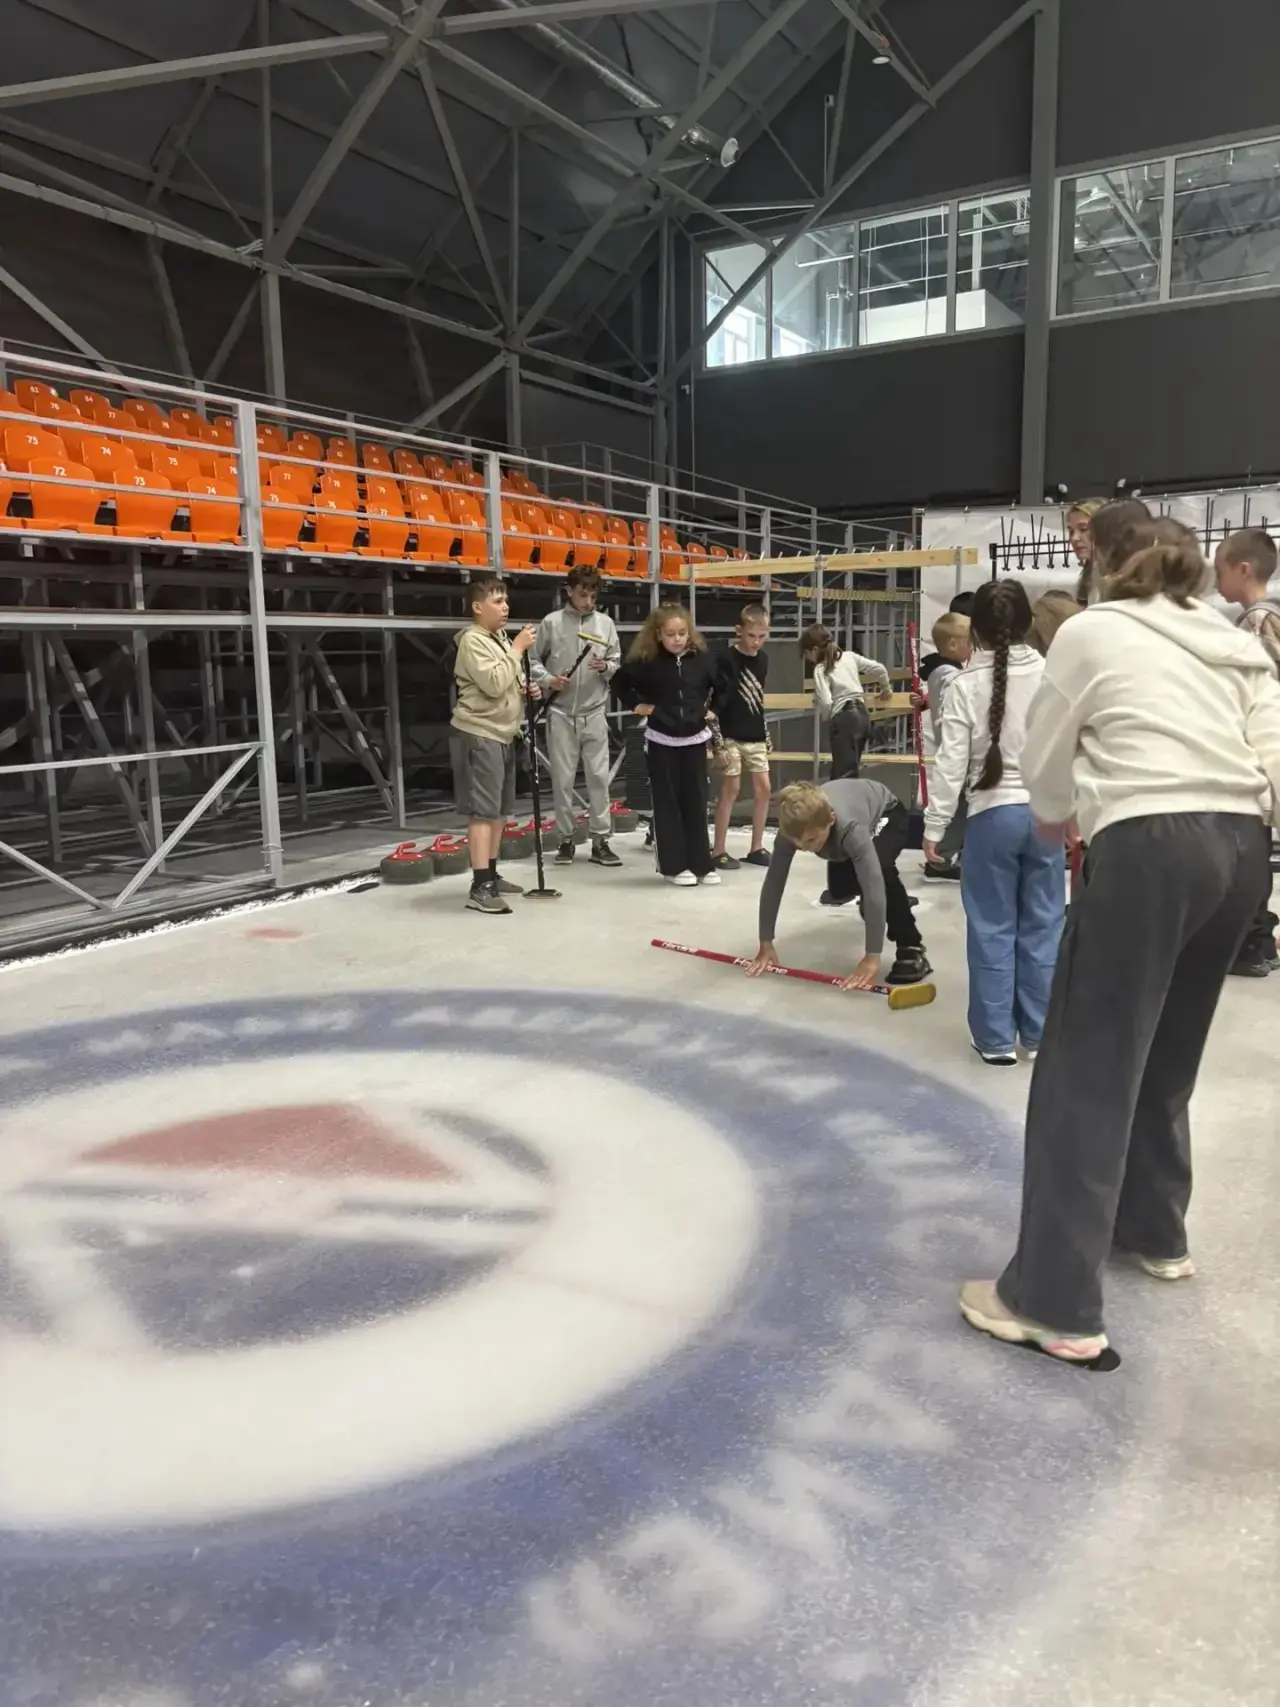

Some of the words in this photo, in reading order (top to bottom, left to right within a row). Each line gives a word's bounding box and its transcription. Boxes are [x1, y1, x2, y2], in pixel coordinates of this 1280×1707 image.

[50, 402, 60, 410] 76
[108, 411, 116, 419] 77
[26, 435, 39, 445] 73
[100, 446, 112, 456] 74
[168, 456, 178, 466] 75
[53, 465, 67, 477] 72
[229, 466, 238, 474] 76
[283, 472, 291, 480] 77
[134, 476, 146, 486] 73
[206, 486, 216, 495] 74
[269, 493, 279, 502] 75
